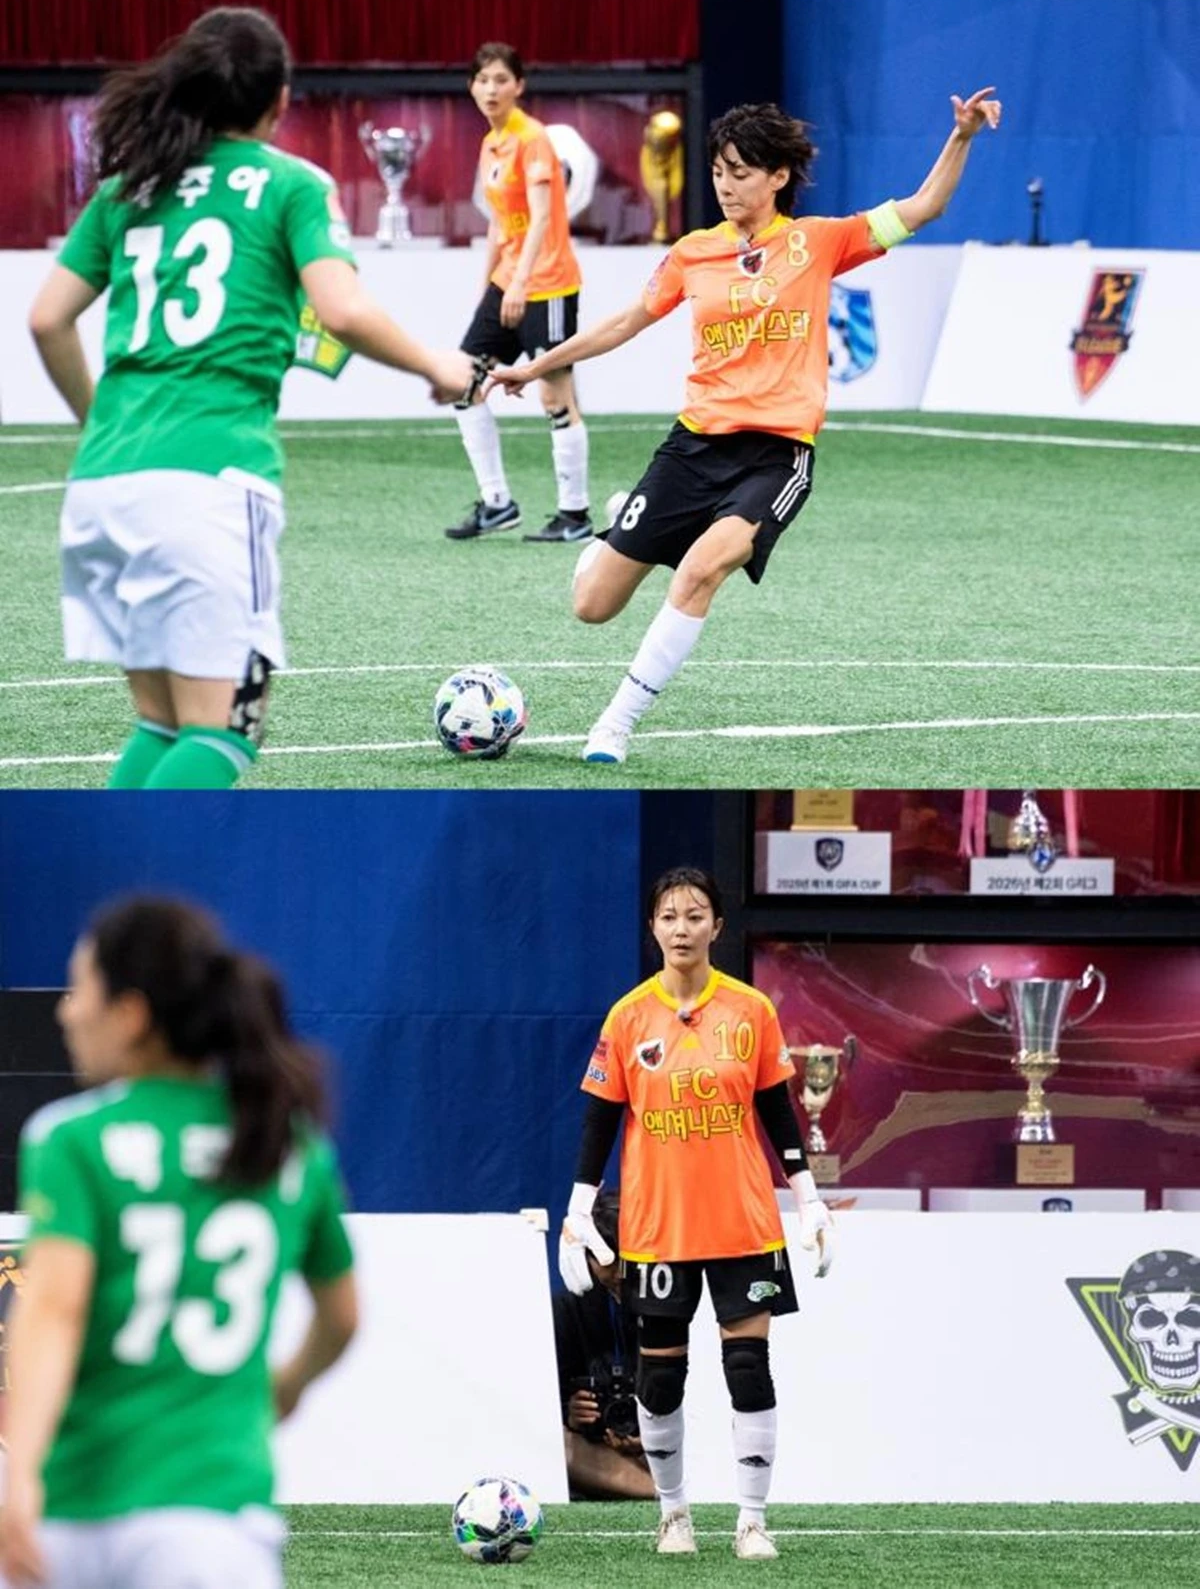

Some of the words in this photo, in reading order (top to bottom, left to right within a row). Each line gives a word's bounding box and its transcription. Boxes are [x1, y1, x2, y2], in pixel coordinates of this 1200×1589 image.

[787, 230, 809, 267] 8
[124, 217, 232, 353] 13
[728, 276, 777, 314] FC
[702, 309, 810, 357] 액셔니스타
[621, 495, 647, 531] 8
[713, 1021, 755, 1062] 10
[670, 1067, 718, 1103] FC
[643, 1102, 745, 1143] 액셔니스타
[111, 1200, 280, 1376] 13
[636, 1263, 673, 1300] 10
